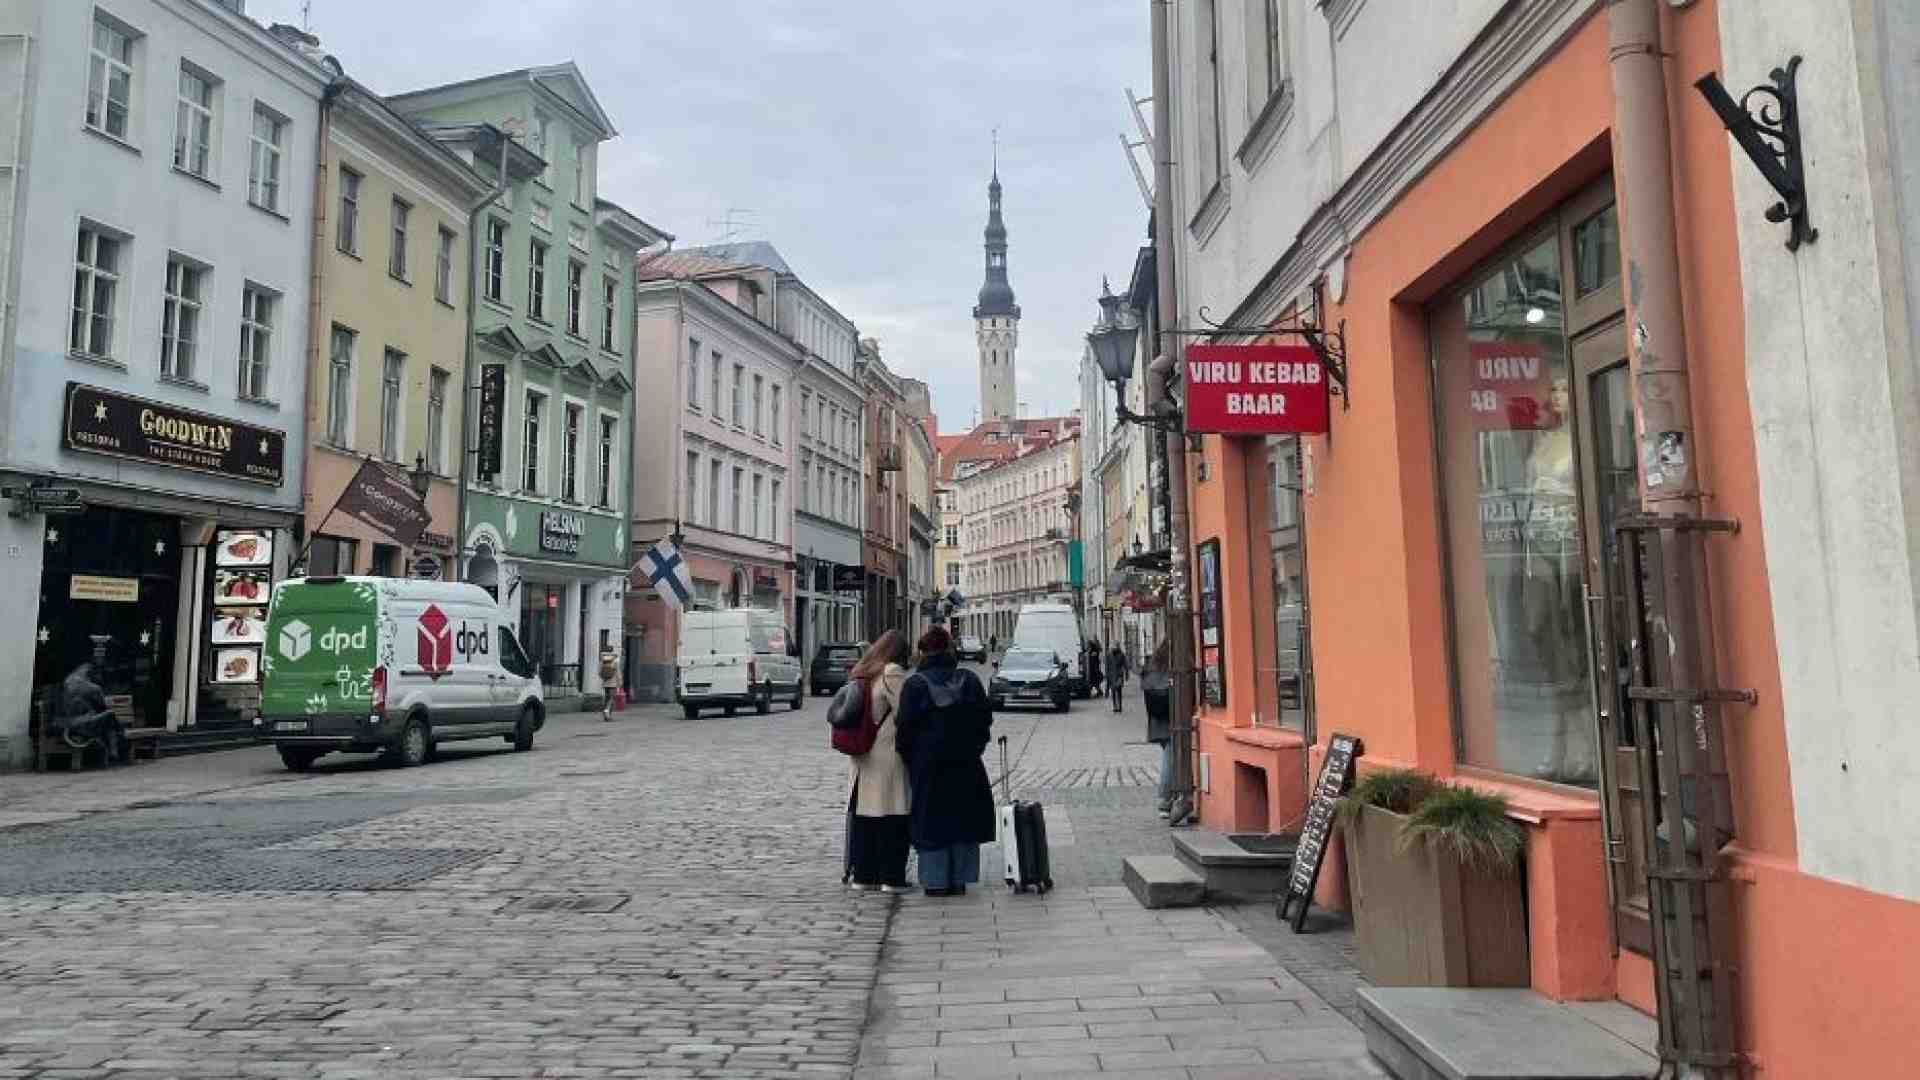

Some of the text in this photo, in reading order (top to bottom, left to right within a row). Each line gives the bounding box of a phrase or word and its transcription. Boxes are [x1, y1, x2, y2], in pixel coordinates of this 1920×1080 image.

[1188, 361, 1322, 385] VIRU KEBAB
[1226, 392, 1286, 415] BAAR
[139, 408, 232, 451] GOODWIN
[320, 625, 367, 656] dpd
[456, 620, 489, 663] dpd
